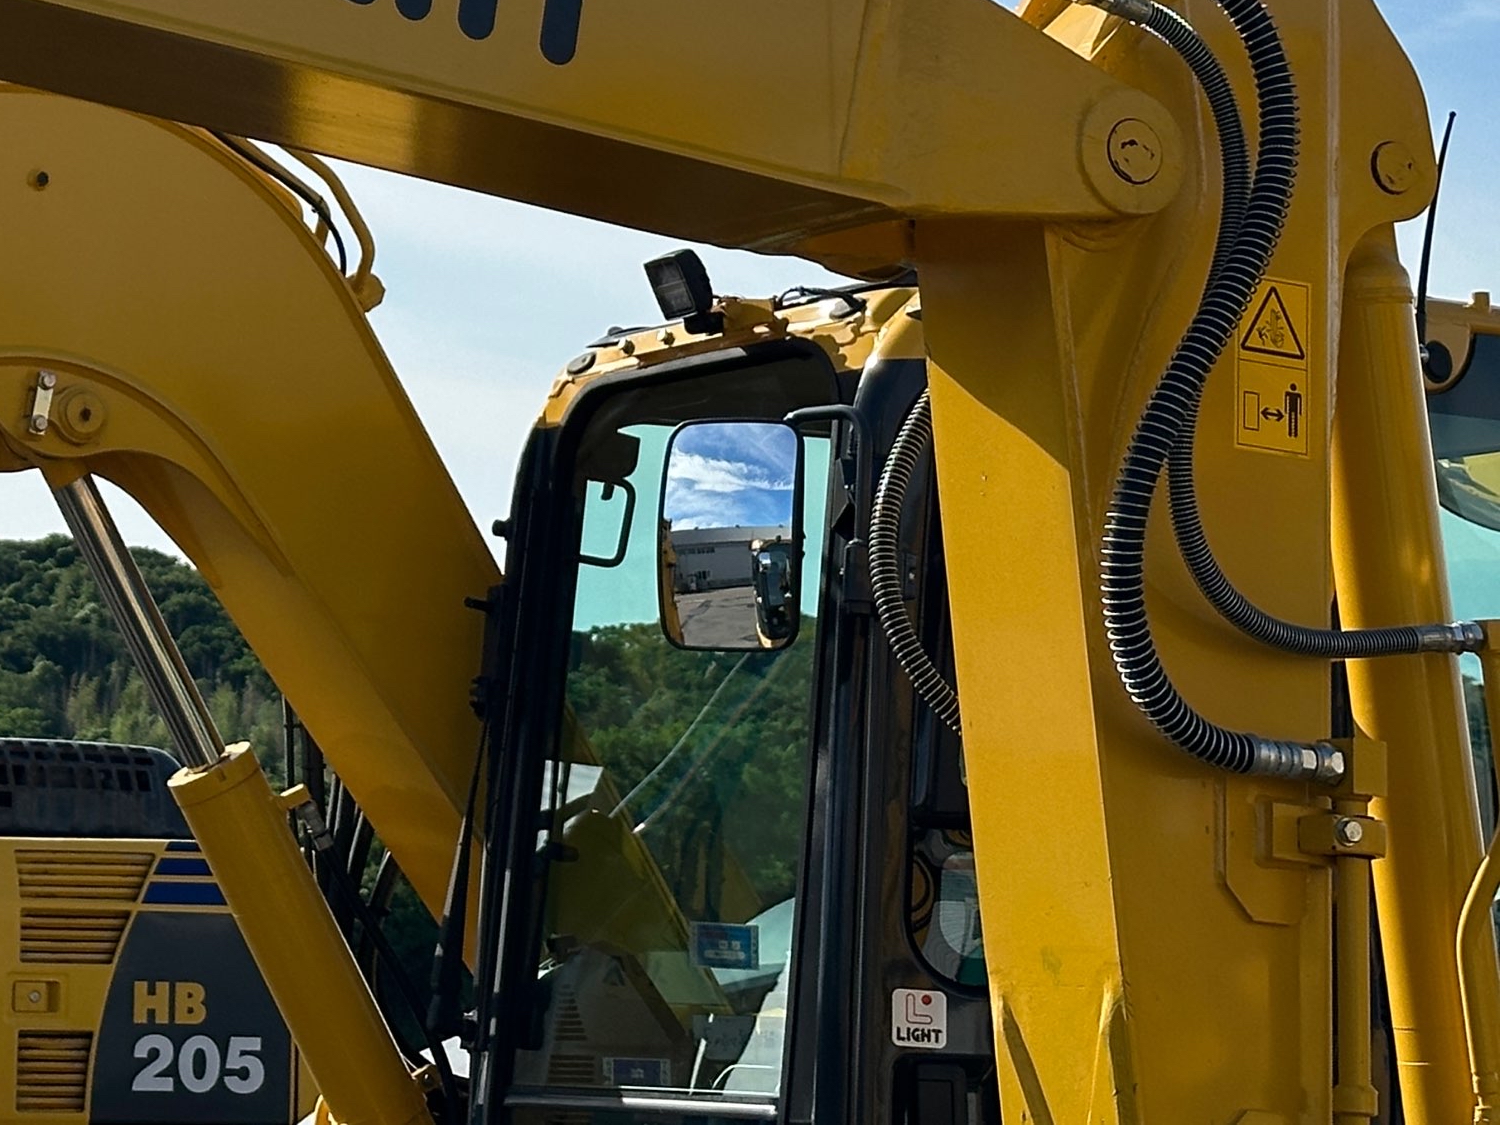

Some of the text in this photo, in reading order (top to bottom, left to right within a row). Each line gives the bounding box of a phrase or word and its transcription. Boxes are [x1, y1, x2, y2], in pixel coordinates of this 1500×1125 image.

[133, 981, 207, 1024] HB
[896, 1026, 943, 1043] LIGHT
[132, 1034, 266, 1094] 205
